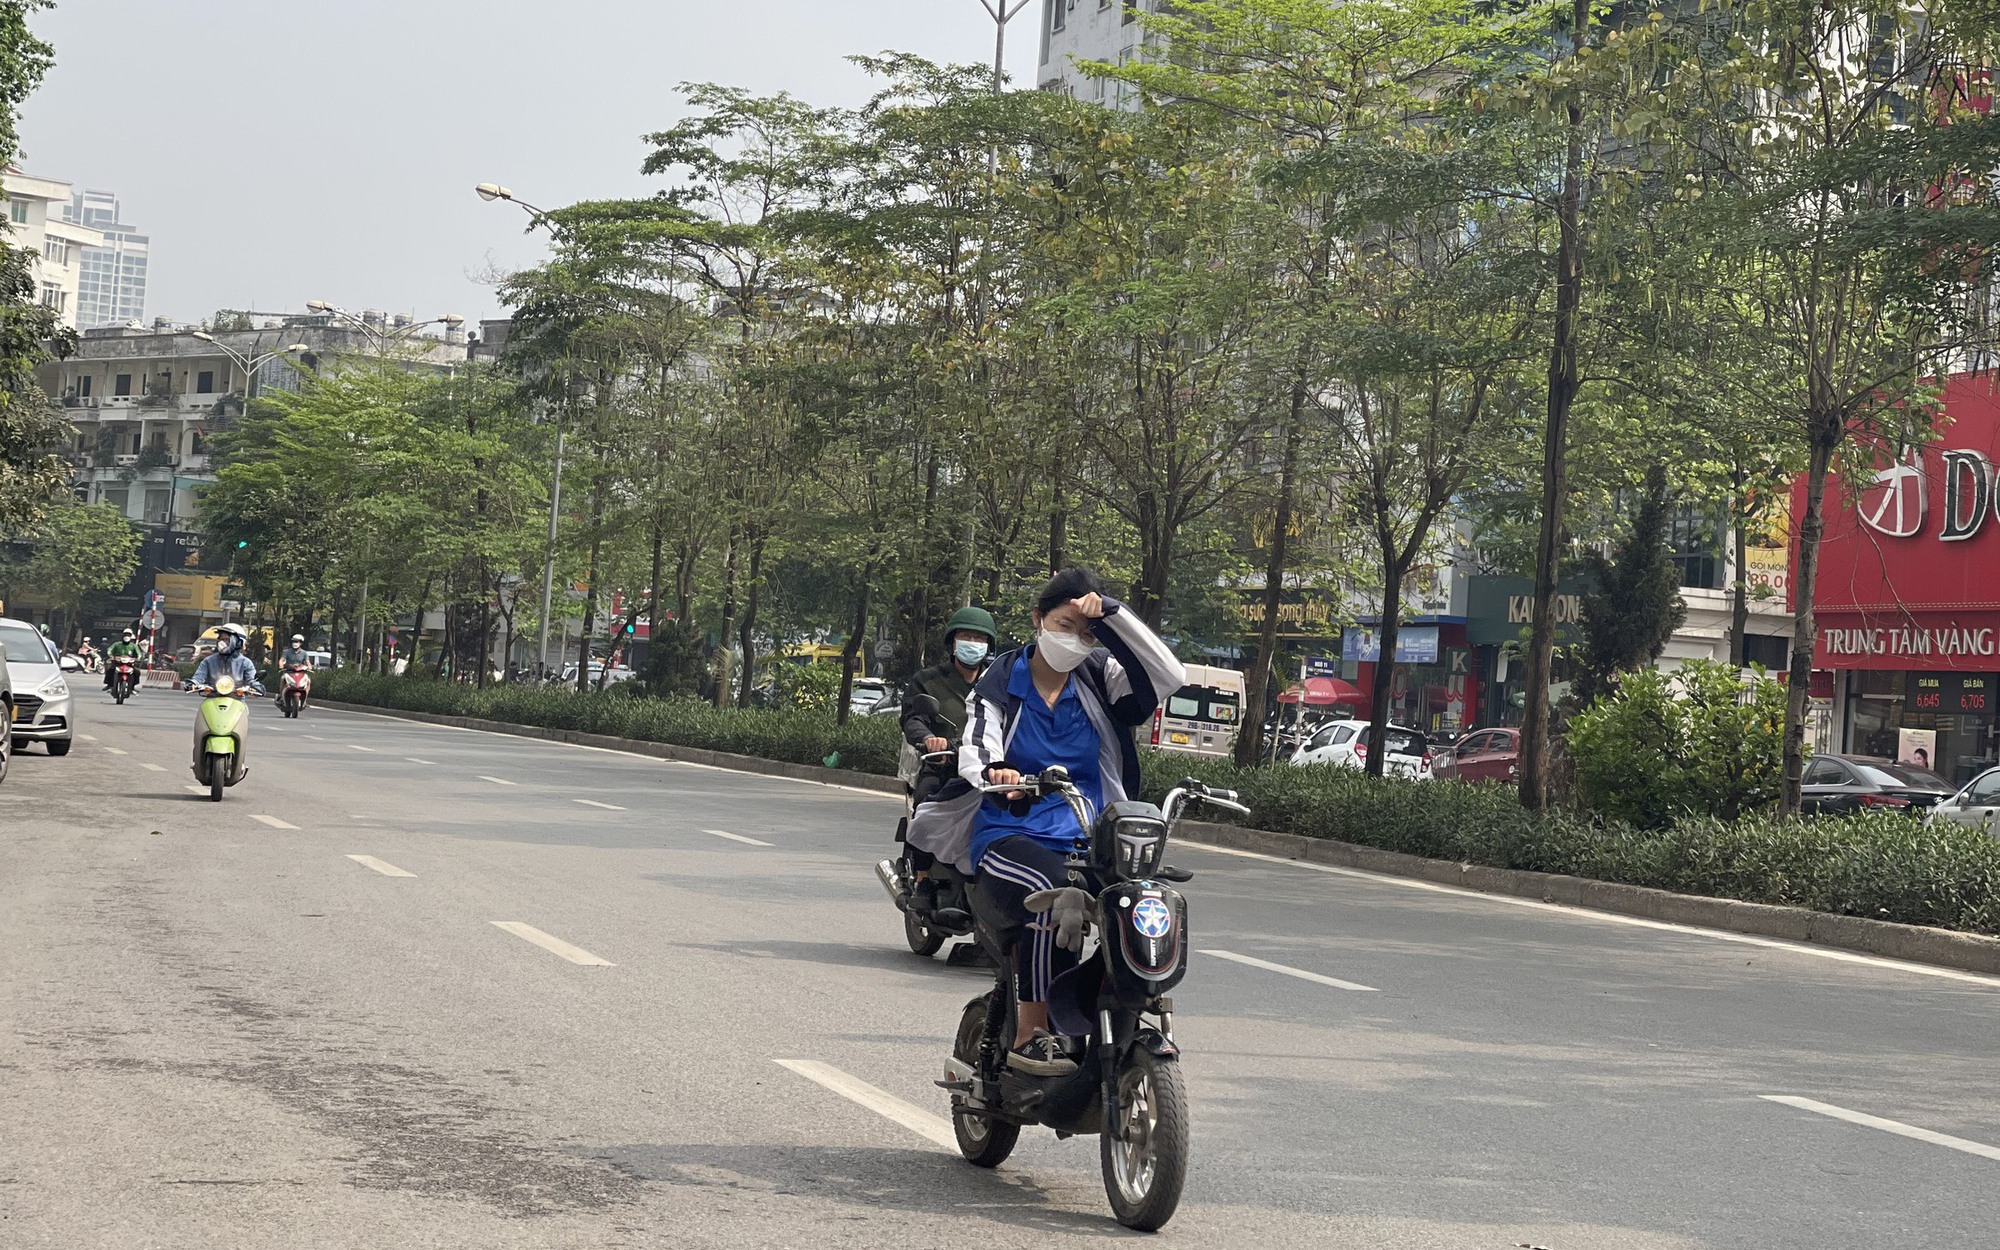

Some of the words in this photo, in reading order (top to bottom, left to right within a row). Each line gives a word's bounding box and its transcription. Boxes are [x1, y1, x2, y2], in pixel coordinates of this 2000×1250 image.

[1939, 449, 2000, 541] D
[1824, 628, 1886, 655] TRUNG
[1888, 622, 1931, 655] TÂM
[1936, 620, 1994, 656] VÀNG
[1451, 650, 1468, 673] K
